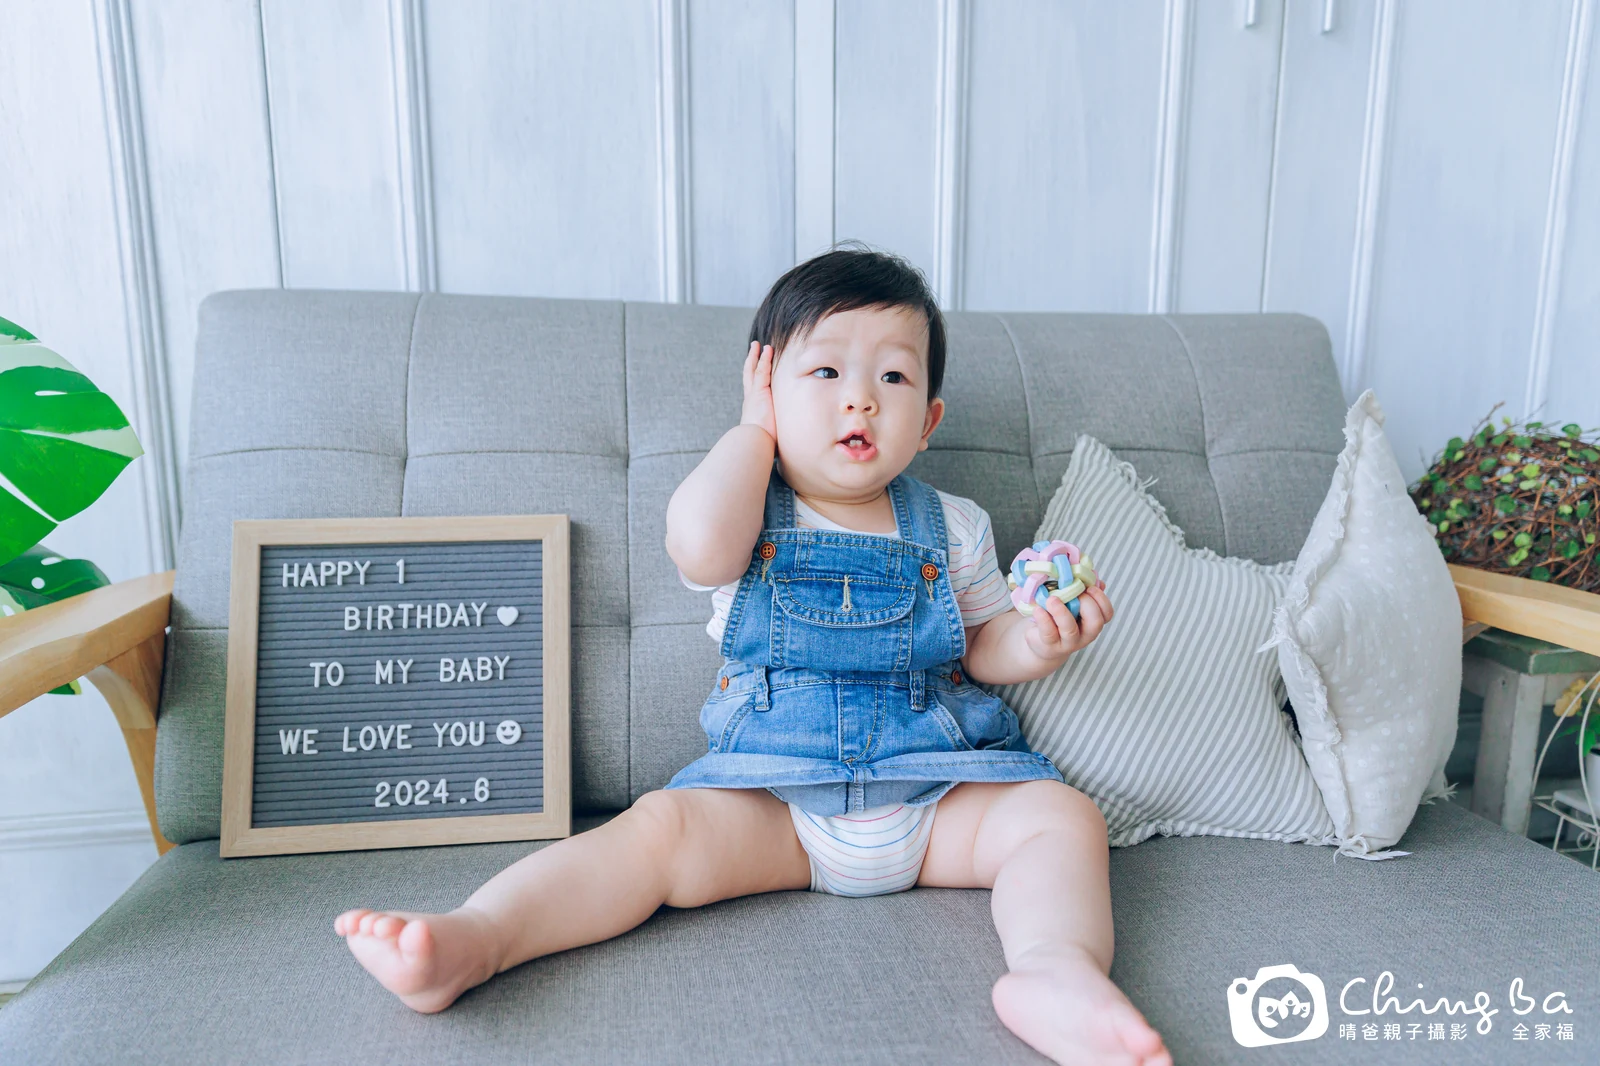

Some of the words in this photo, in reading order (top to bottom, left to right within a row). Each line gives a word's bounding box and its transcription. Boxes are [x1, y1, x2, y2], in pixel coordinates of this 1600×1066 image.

[282, 560, 371, 587] HAPPY
[396, 559, 405, 585] 1
[344, 602, 488, 631] BIRTHDAY
[309, 661, 345, 687] TO
[375, 658, 414, 685] MY
[439, 655, 510, 682] BABY
[279, 728, 319, 755] WE
[342, 724, 413, 753] LOVE
[432, 720, 485, 748] YOU
[374, 777, 490, 807] 2024.6
